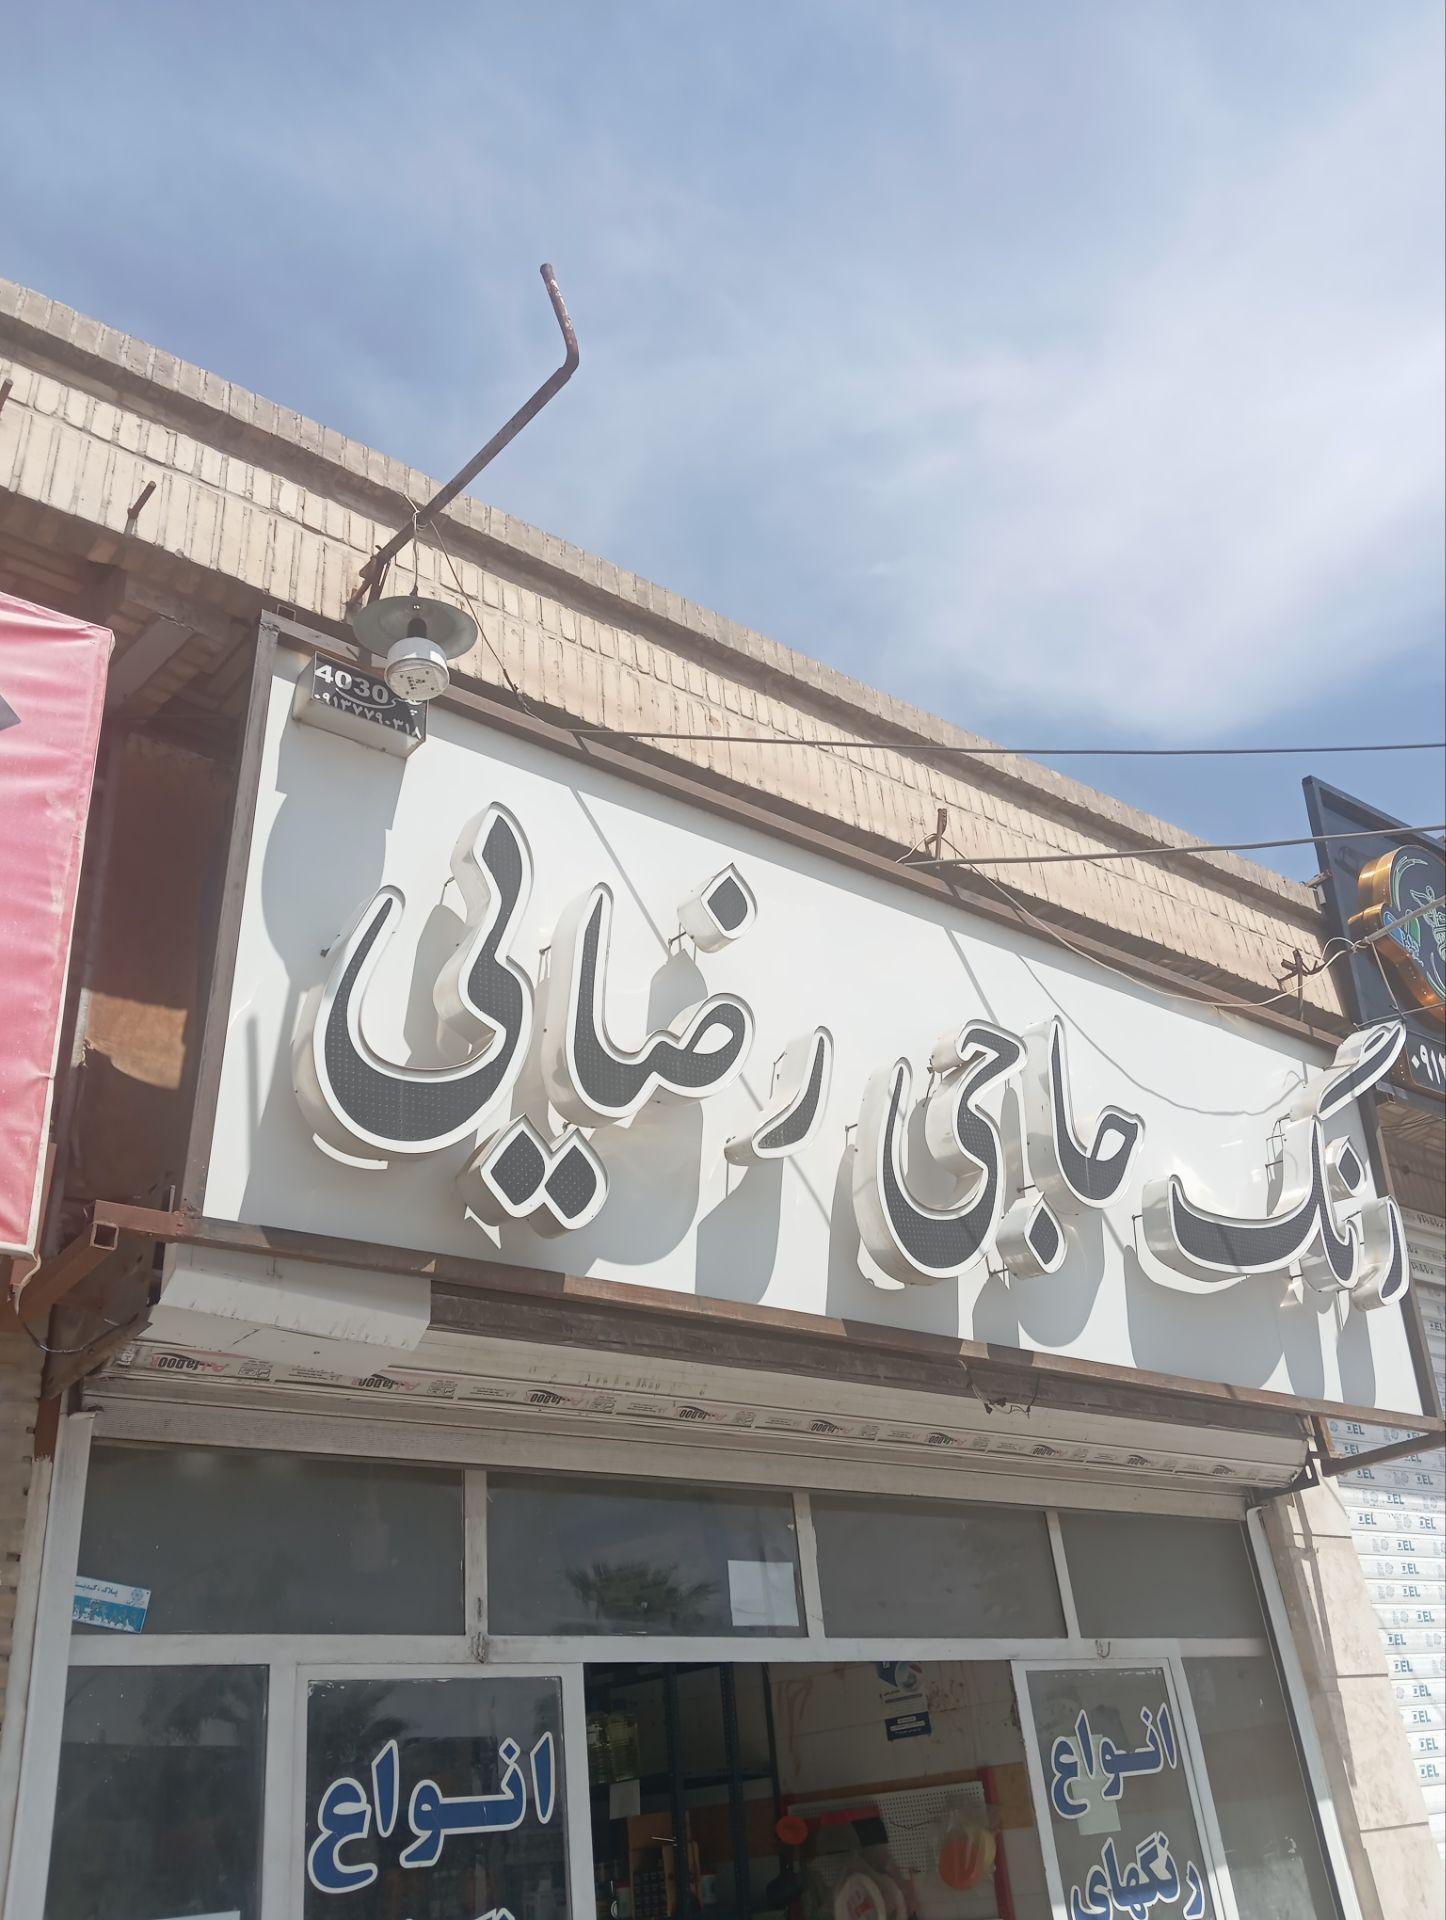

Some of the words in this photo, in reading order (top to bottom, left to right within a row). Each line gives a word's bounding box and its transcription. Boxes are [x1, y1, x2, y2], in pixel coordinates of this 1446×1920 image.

[314, 664, 389, 704] 4030
[306, 800, 836, 1233] رضایی
[308, 1731, 555, 1894] انواع
[1052, 1702, 1177, 1819] انواع
[1071, 1831, 1205, 1920] رنگهای
